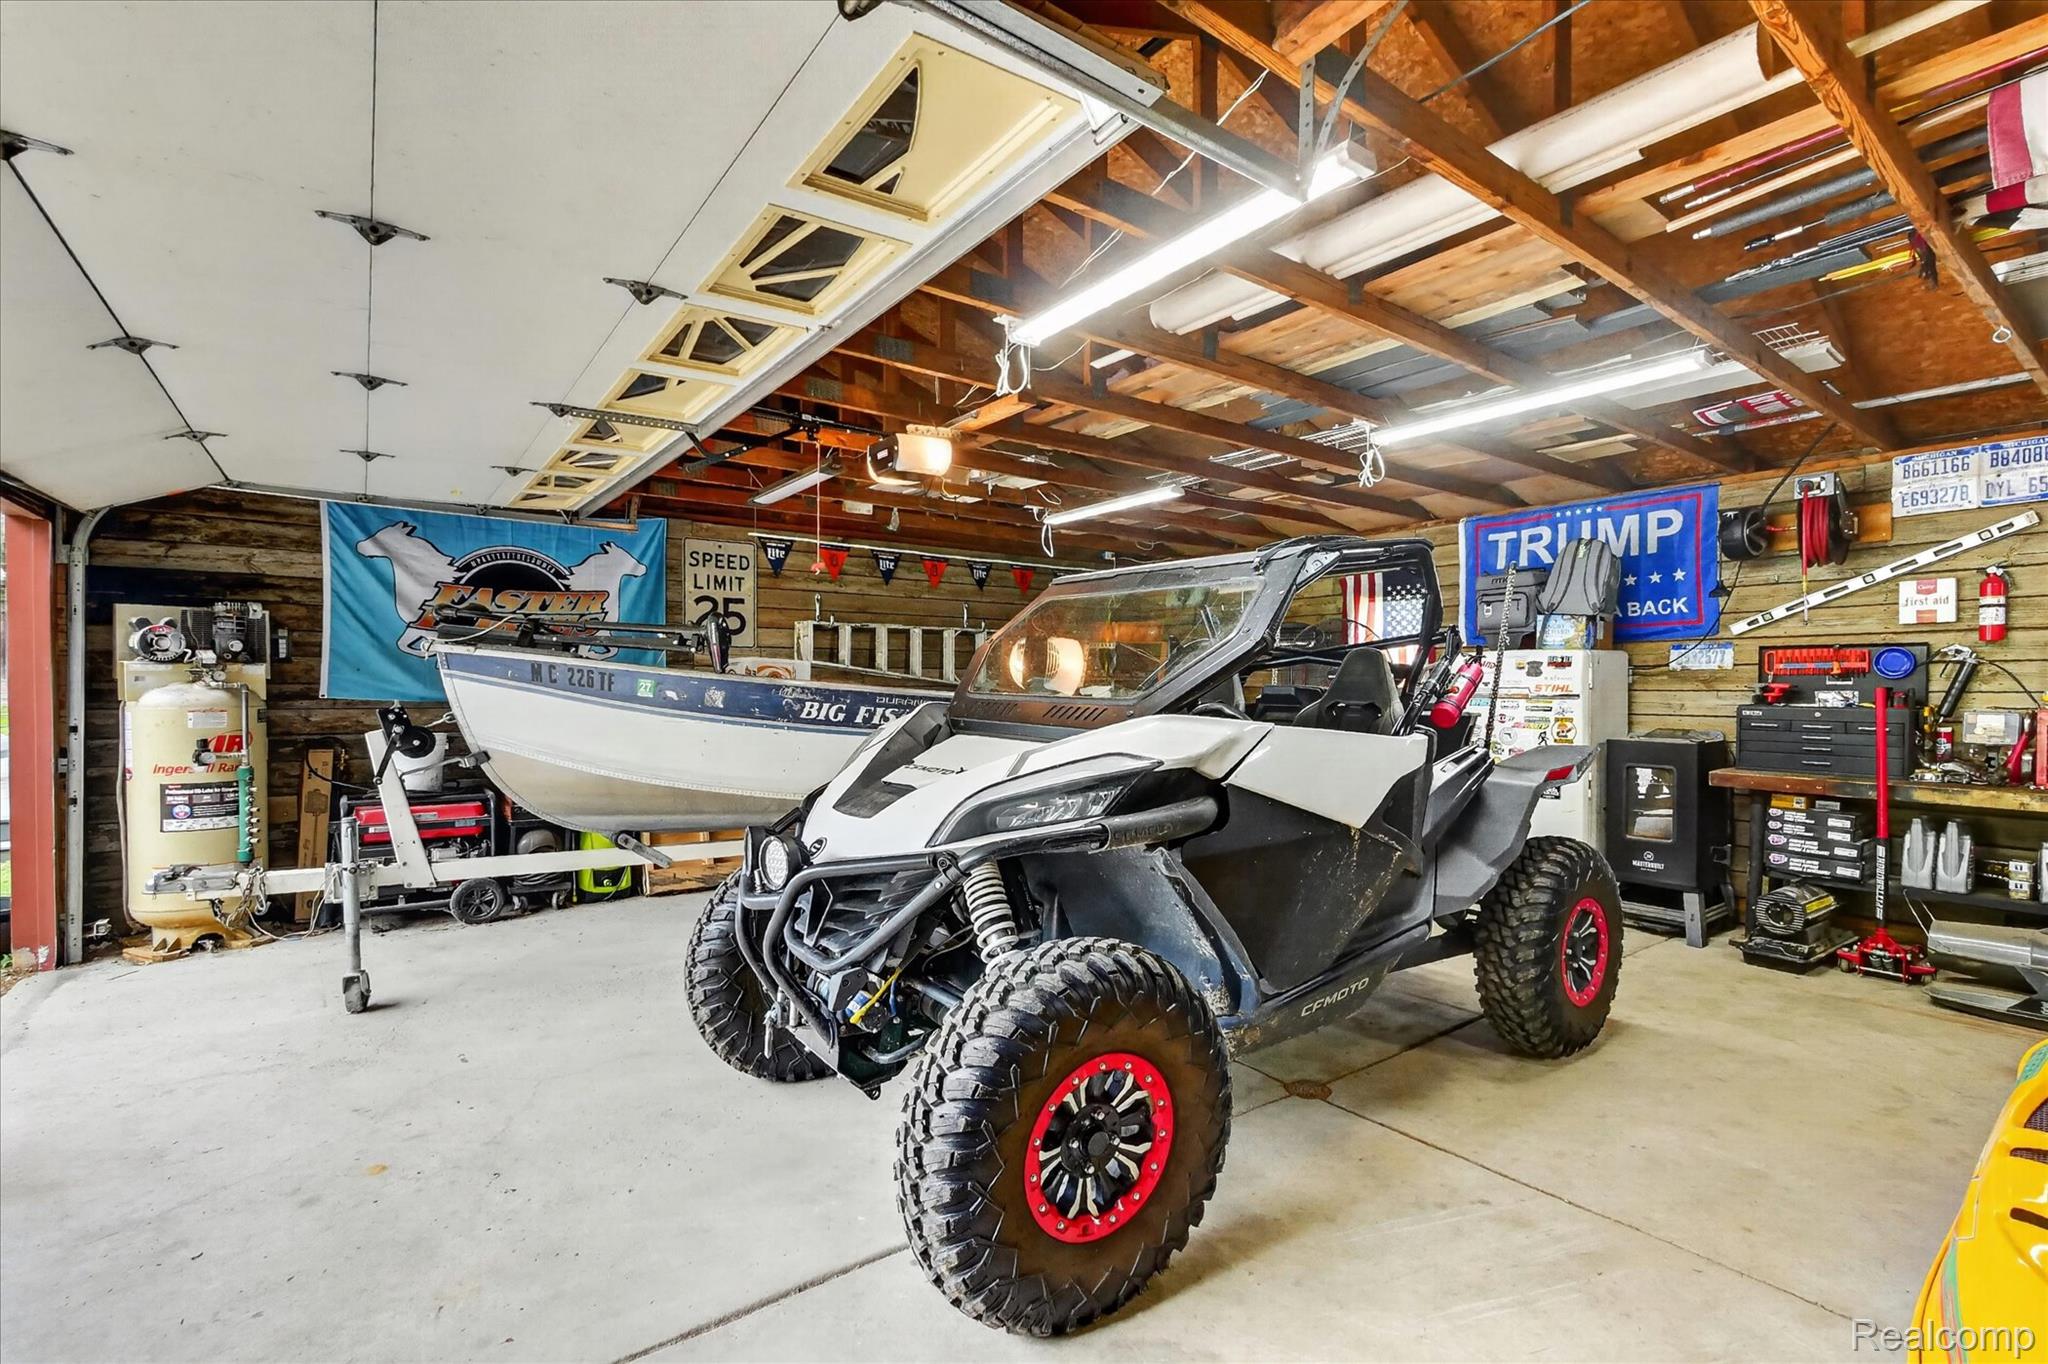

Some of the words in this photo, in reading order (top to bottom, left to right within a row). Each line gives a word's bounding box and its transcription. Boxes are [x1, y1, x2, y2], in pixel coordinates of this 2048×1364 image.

[1903, 455, 1970, 479] B661166
[689, 551, 750, 571] SPEED
[767, 548, 786, 559] Lite
[879, 559, 896, 571] Lite
[973, 569, 988, 580] Lite
[693, 574, 746, 593] LIMIT
[439, 584, 608, 615] FASTER
[1627, 597, 1689, 618] BACK
[1903, 596, 1929, 607] first
[1933, 596, 1950, 605] aid
[694, 595, 746, 637] 25
[567, 667, 595, 689] 226
[640, 682, 652, 691] 27
[1534, 683, 1574, 693] STIHL
[800, 701, 847, 722] BIG
[1301, 977, 1369, 1017] CFMOTO
